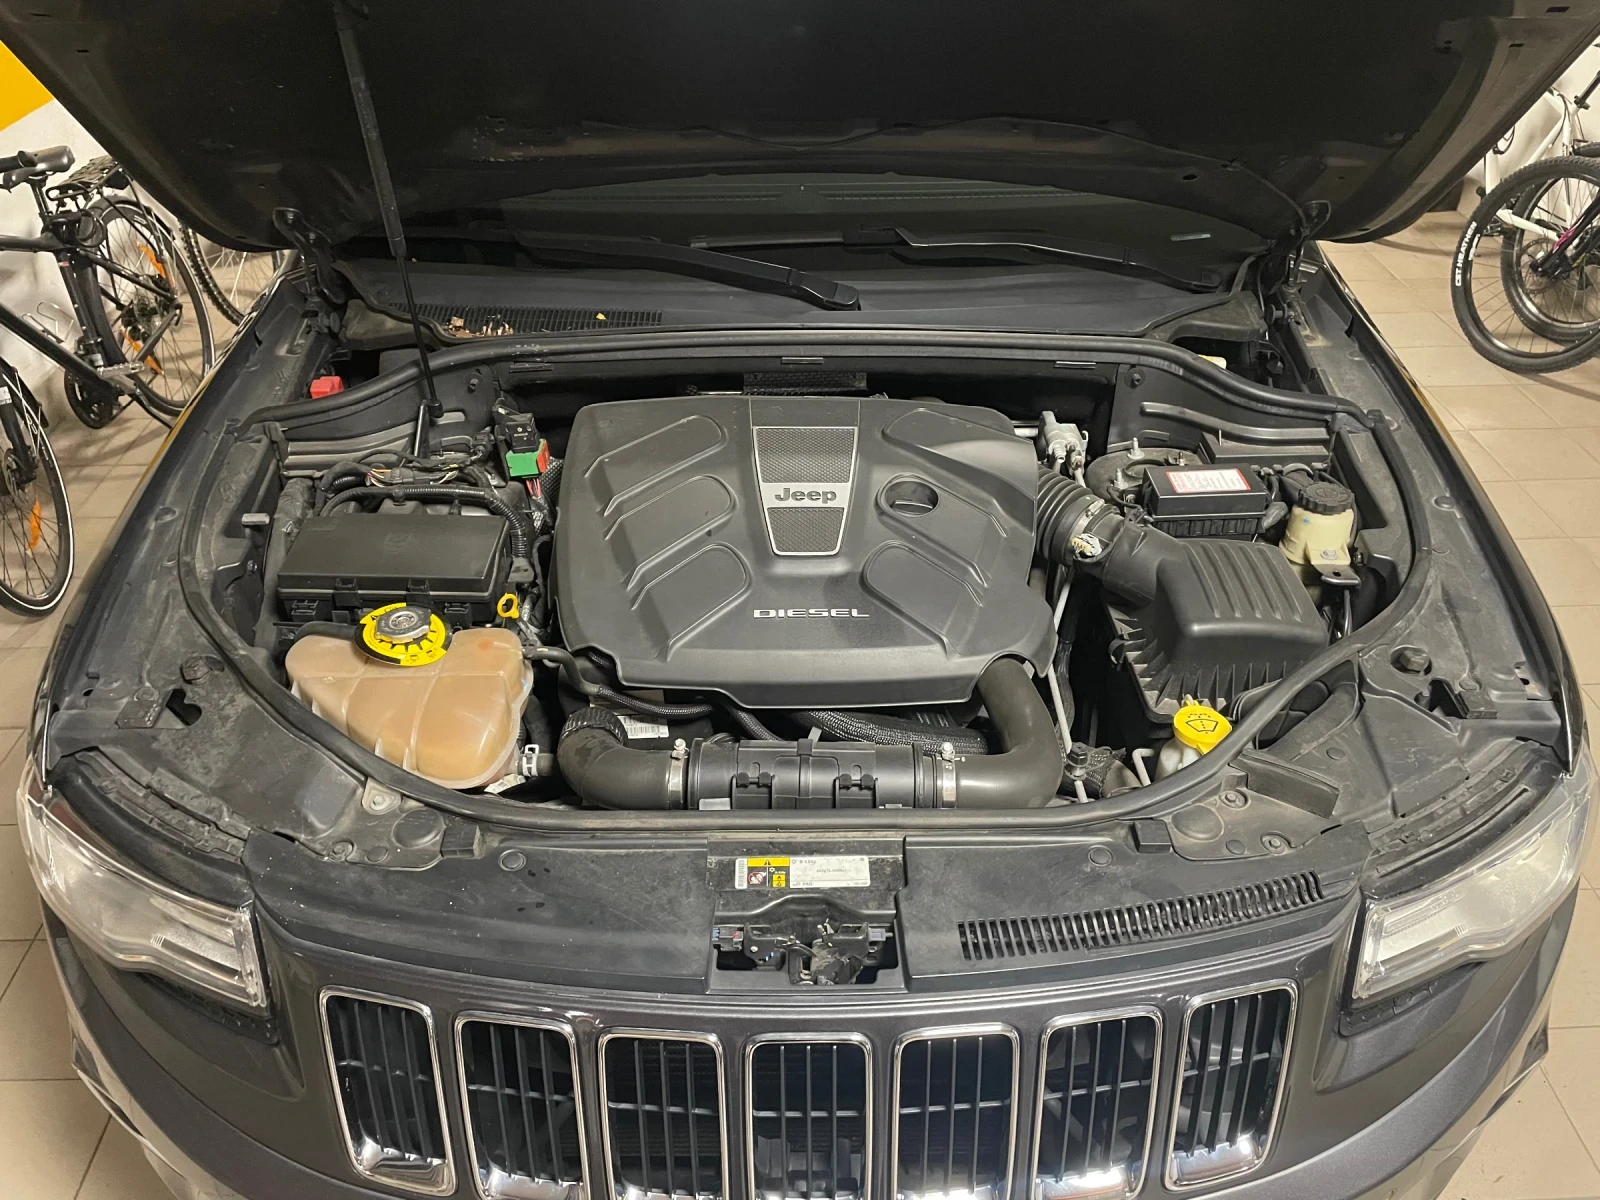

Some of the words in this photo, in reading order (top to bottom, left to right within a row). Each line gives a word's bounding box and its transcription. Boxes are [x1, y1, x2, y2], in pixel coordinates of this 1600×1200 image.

[1456, 220, 1478, 268] HEATHEN
[774, 487, 837, 504] Jeep
[753, 608, 870, 619] DIESEL
